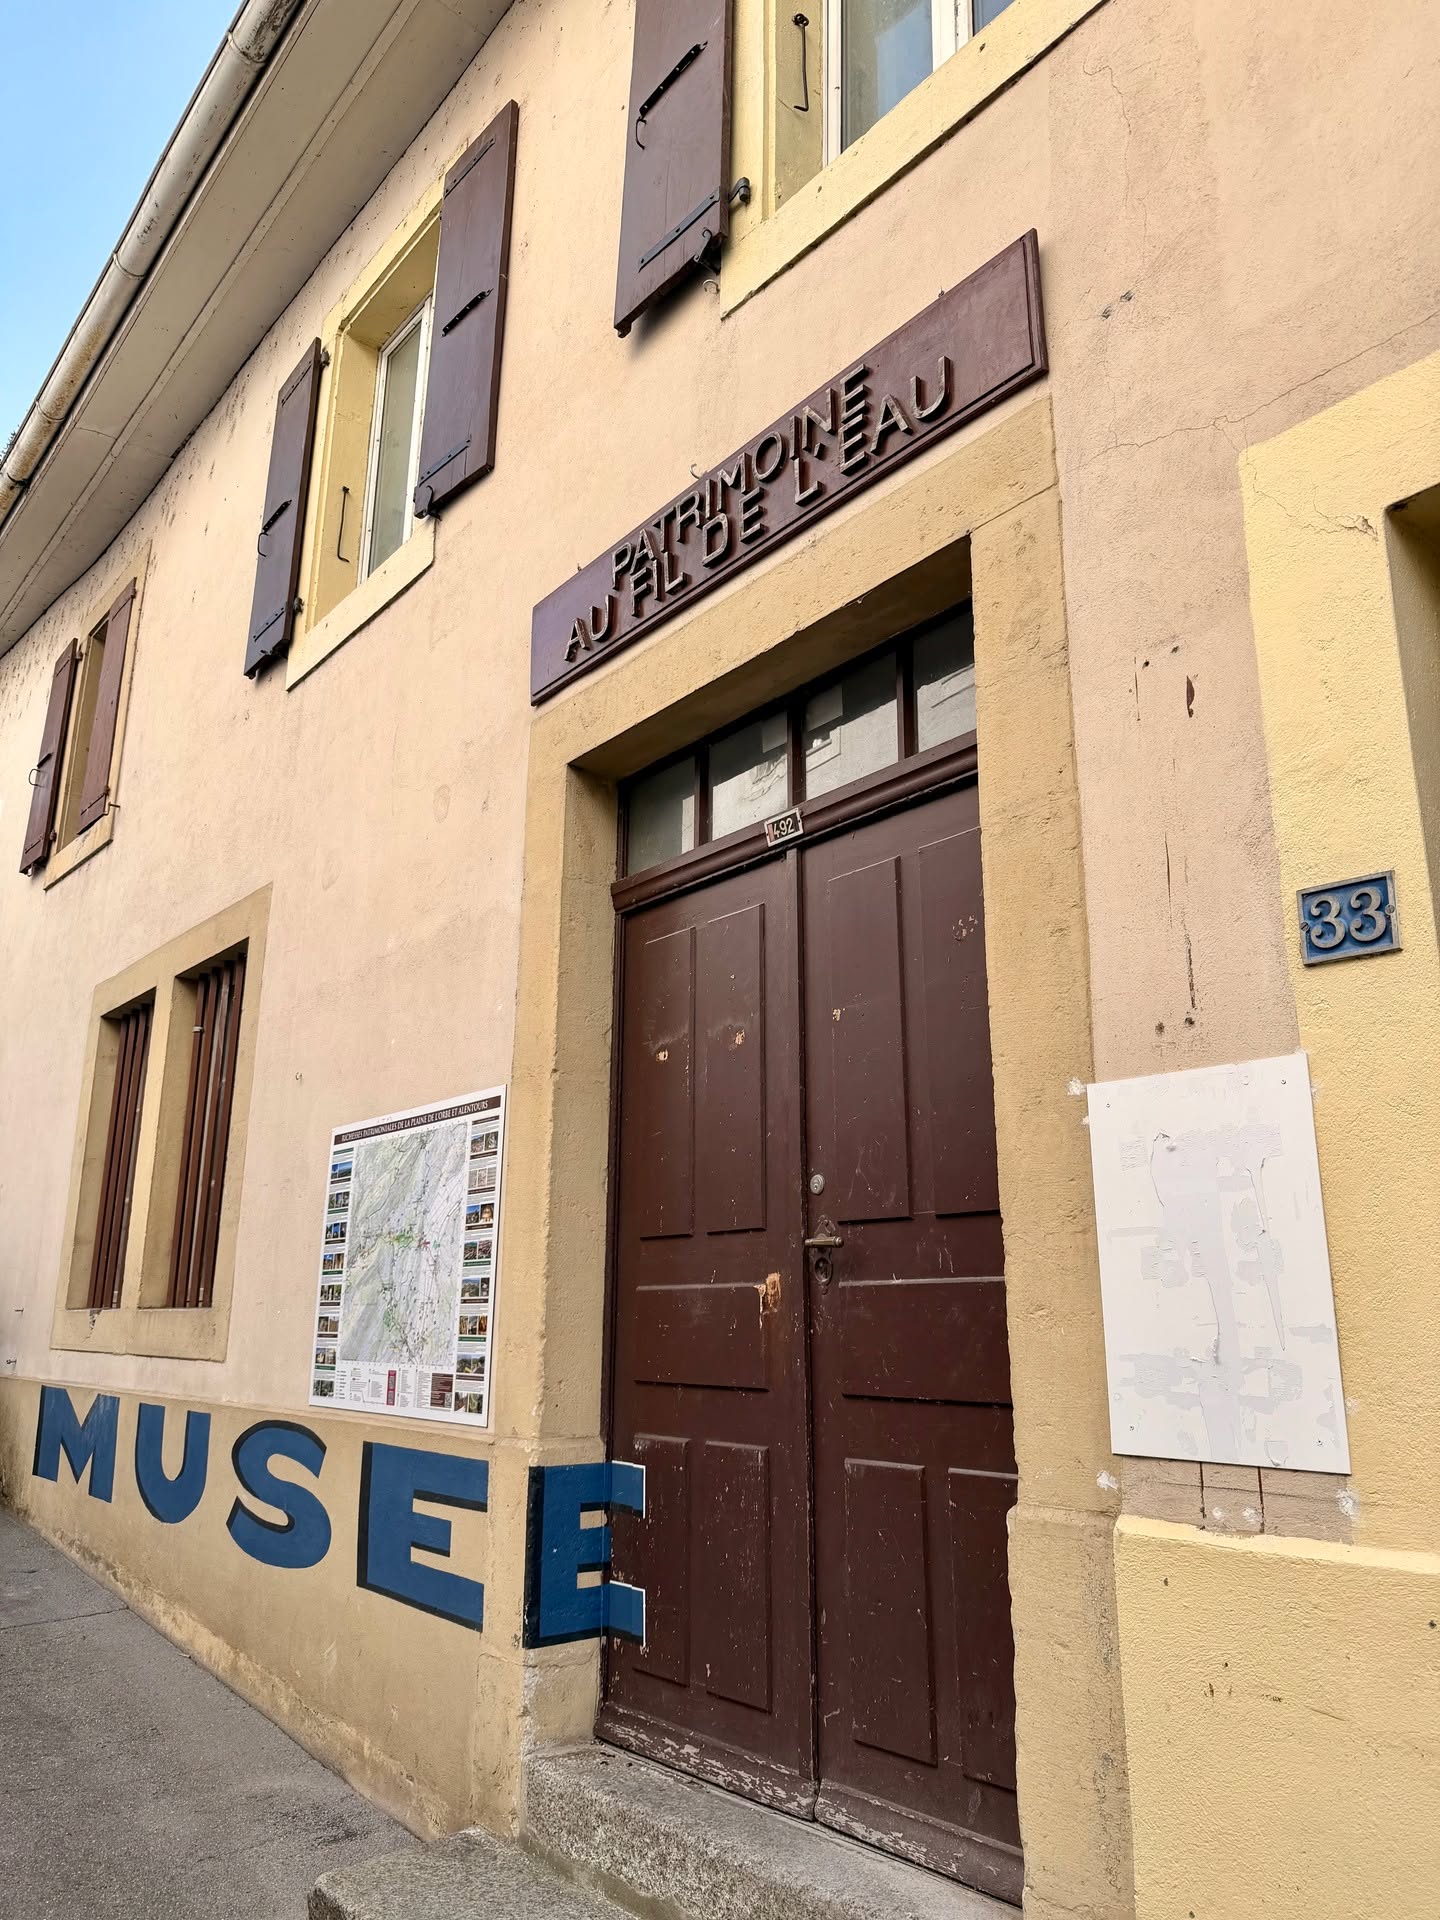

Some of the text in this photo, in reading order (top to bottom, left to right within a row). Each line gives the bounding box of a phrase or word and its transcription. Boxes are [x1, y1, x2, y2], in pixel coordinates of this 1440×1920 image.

[564, 356, 952, 662] AU FIL DE L'EAU
[612, 363, 870, 590] PATRIMOINE
[773, 817, 795, 838] 492
[1310, 886, 1387, 949] 33
[397, 1120, 405, 1131] DE
[405, 1119, 411, 1129] LA
[411, 1115, 428, 1127] PLAINE
[427, 1112, 435, 1122] DE
[451, 1106, 458, 1117] ET
[458, 1100, 489, 1115] ALENTOURS
[32, 1384, 647, 1650] MUSEE
